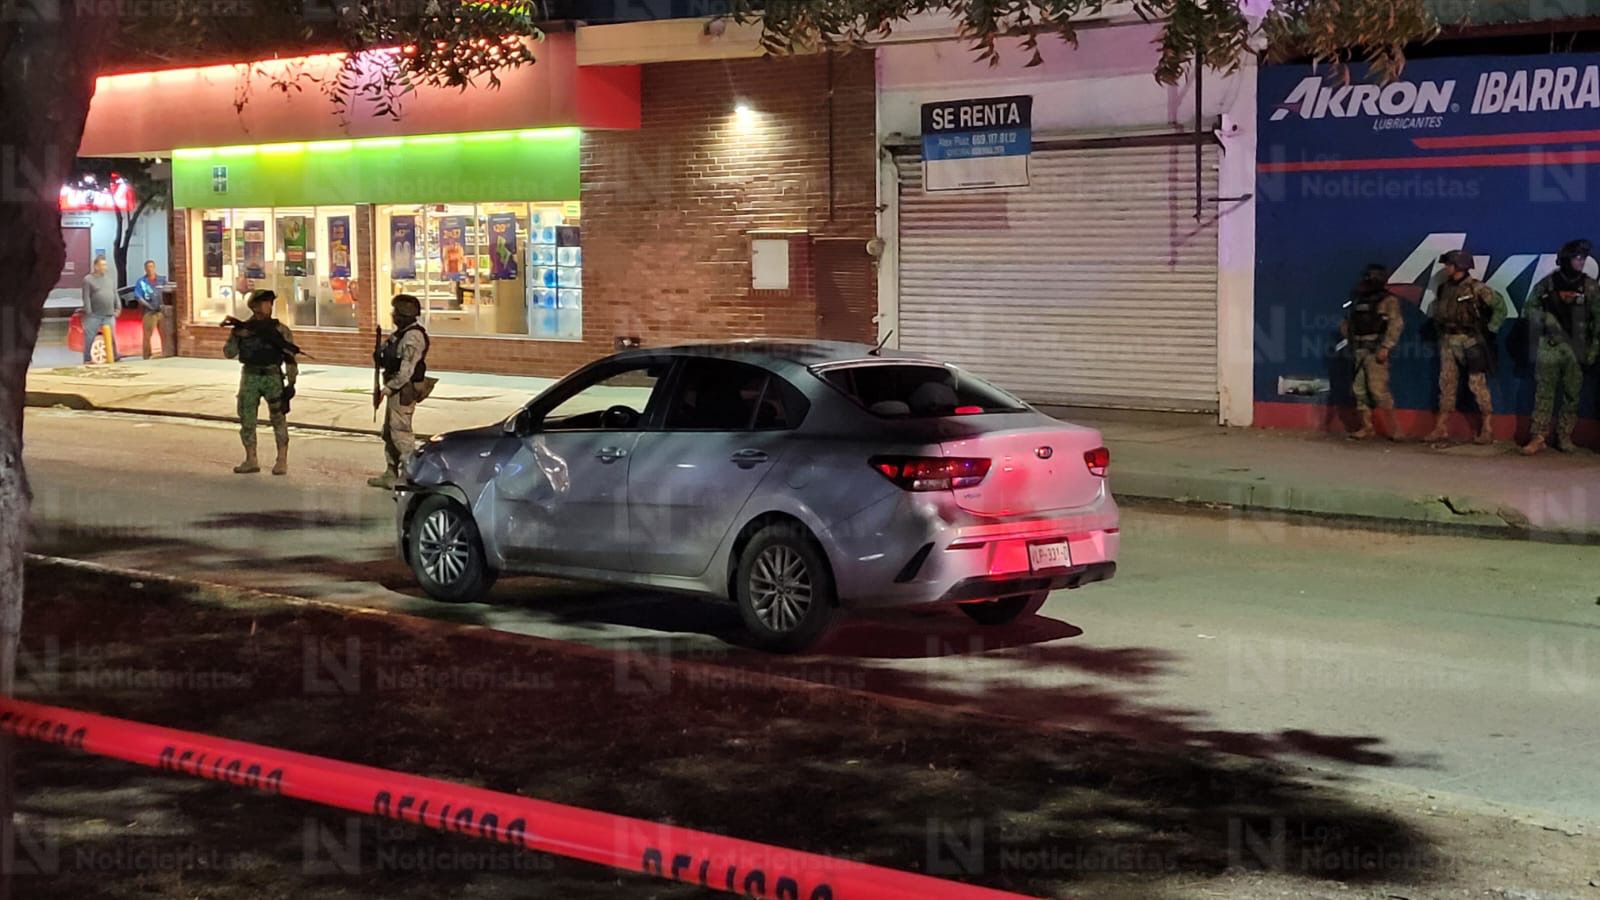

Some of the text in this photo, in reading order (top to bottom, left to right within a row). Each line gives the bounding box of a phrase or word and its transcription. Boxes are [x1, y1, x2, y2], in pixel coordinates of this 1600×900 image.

[1270, 65, 1600, 121] AKRON IBARRA
[932, 102, 1020, 130] SE RENTA
[1373, 116, 1443, 131] LUBRICANTES
